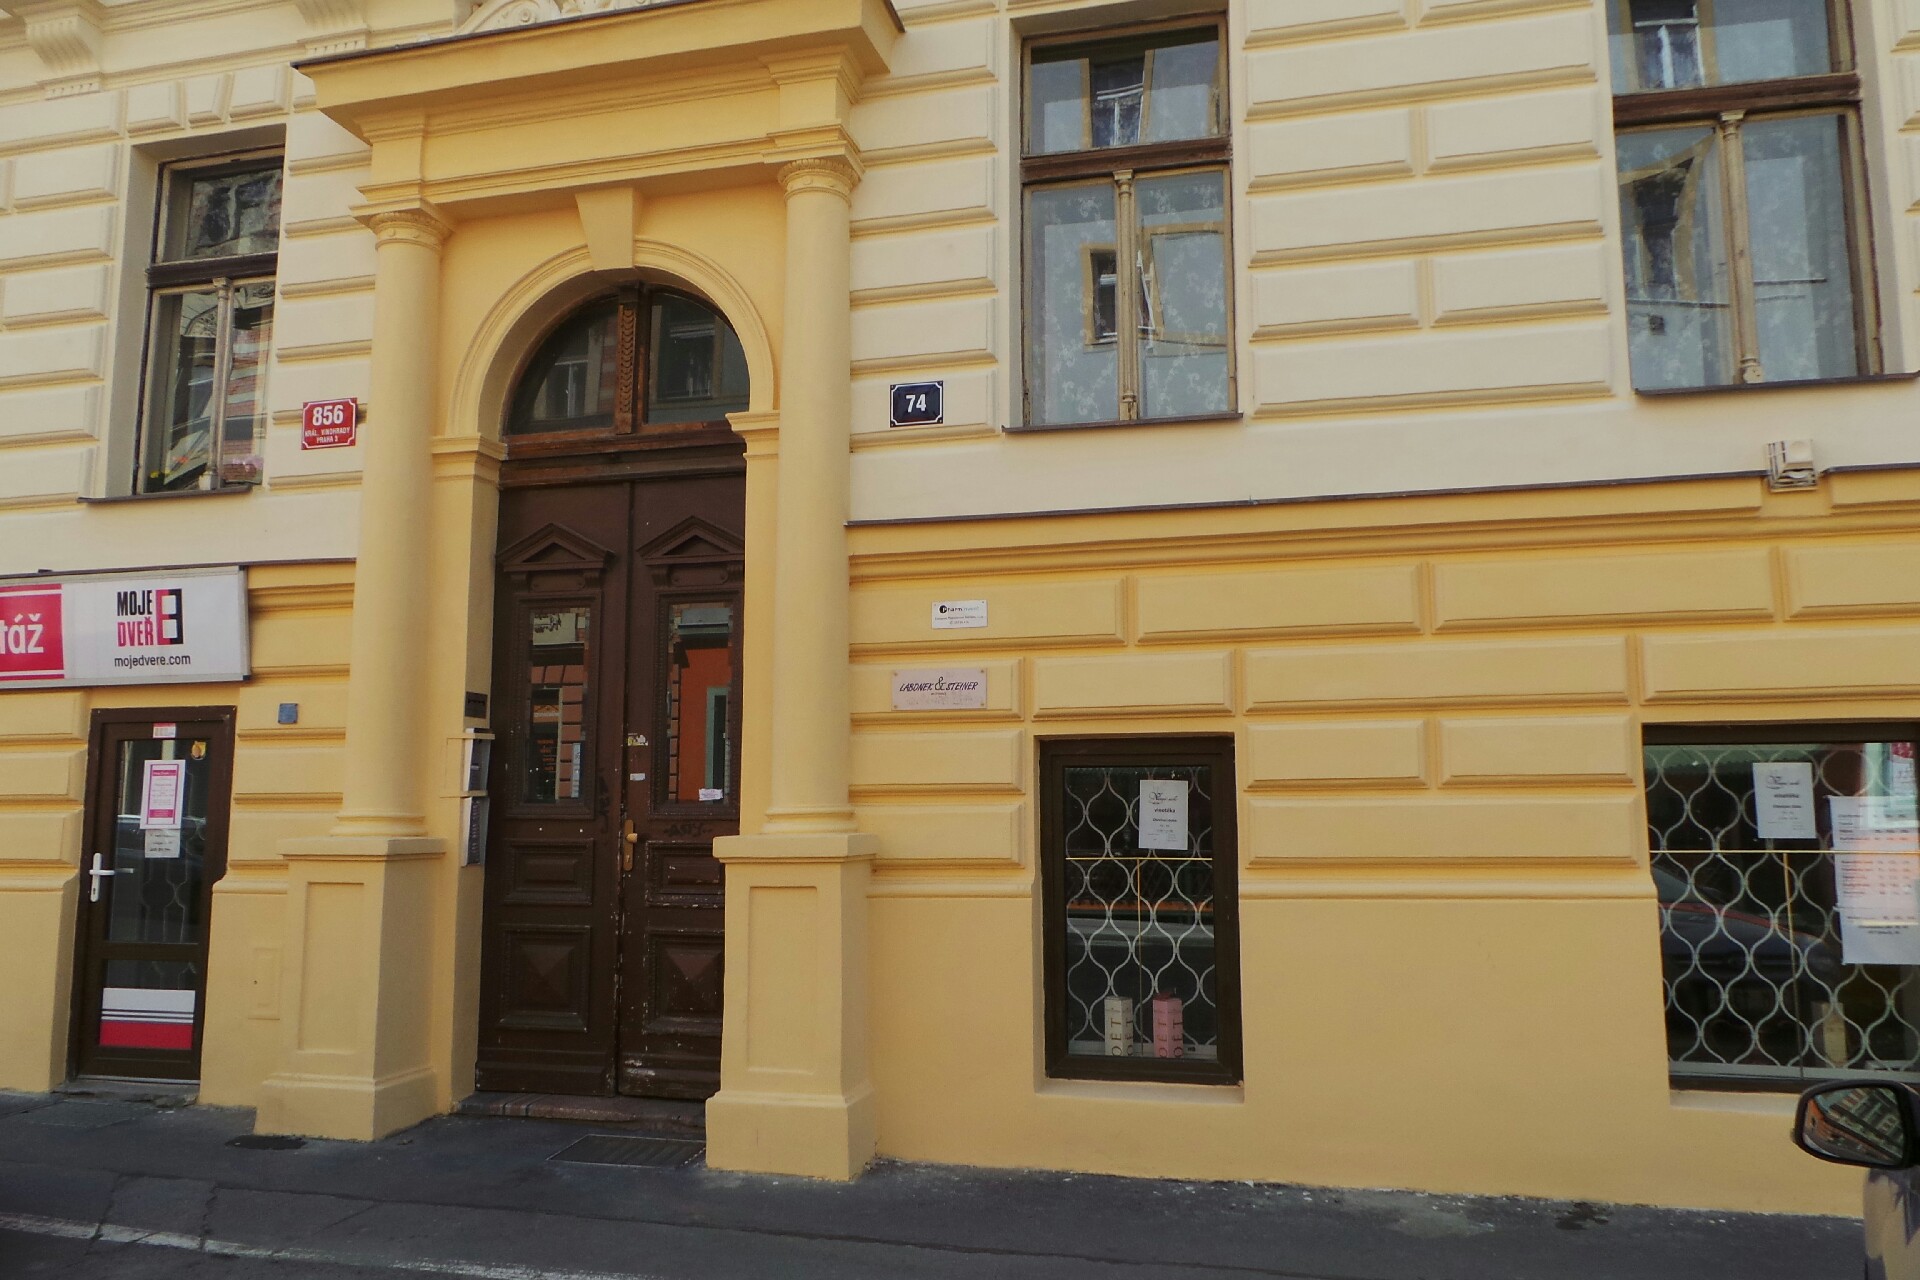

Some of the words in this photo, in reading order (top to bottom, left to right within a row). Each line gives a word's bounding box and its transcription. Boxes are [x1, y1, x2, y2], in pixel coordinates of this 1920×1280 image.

[905, 394, 927, 412] 74
[312, 405, 344, 426] 856
[117, 589, 153, 616] MOJE
[114, 653, 191, 668] mojedvere.com
[934, 676, 946, 691] &
[946, 681, 979, 691] STEINER
